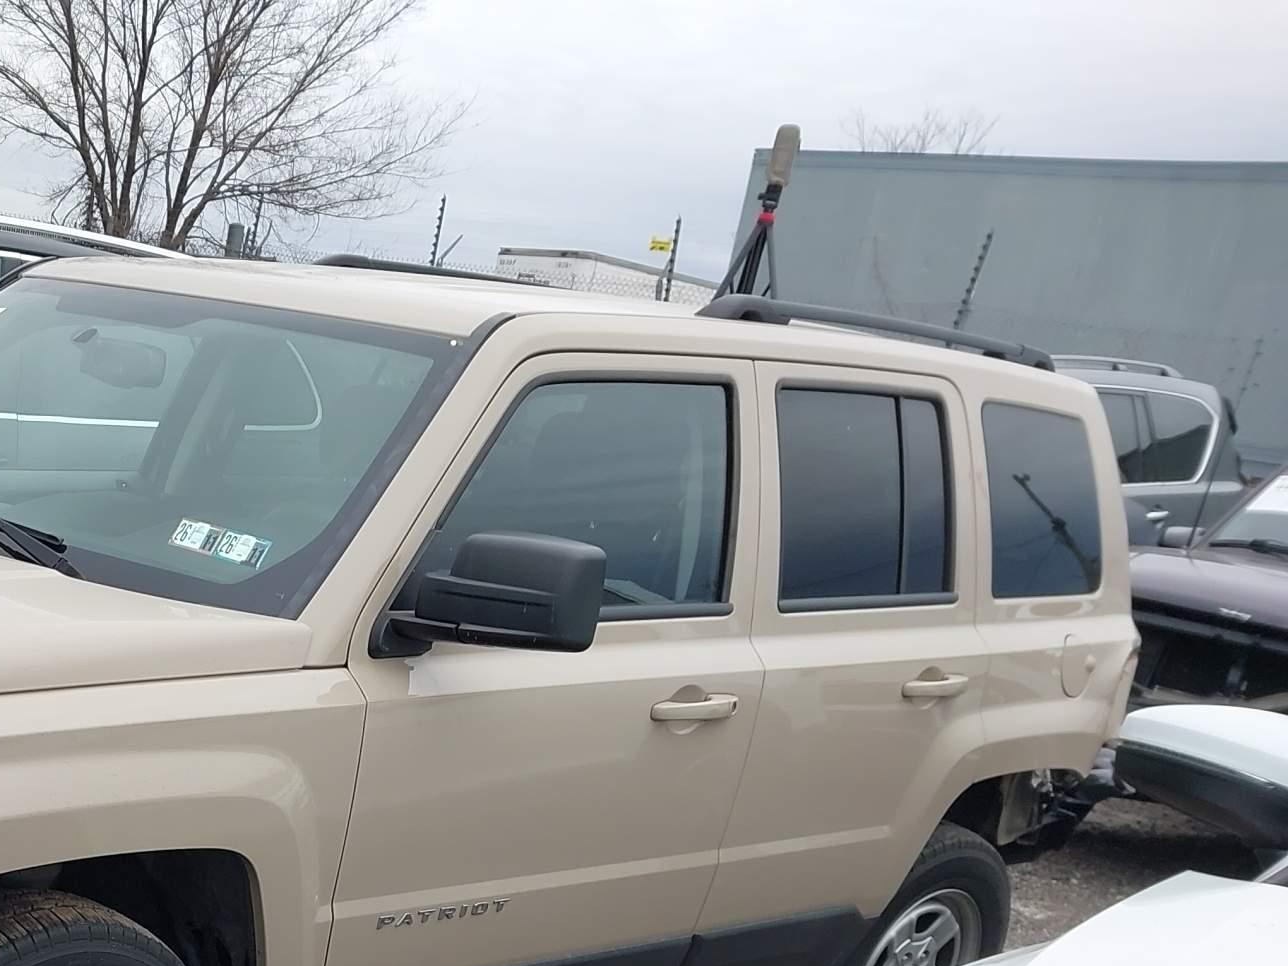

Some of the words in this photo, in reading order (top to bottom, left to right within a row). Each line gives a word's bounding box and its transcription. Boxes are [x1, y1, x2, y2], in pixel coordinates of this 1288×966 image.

[174, 522, 192, 542] 26
[219, 534, 238, 554] 26
[376, 898, 511, 930] PATRIOT
